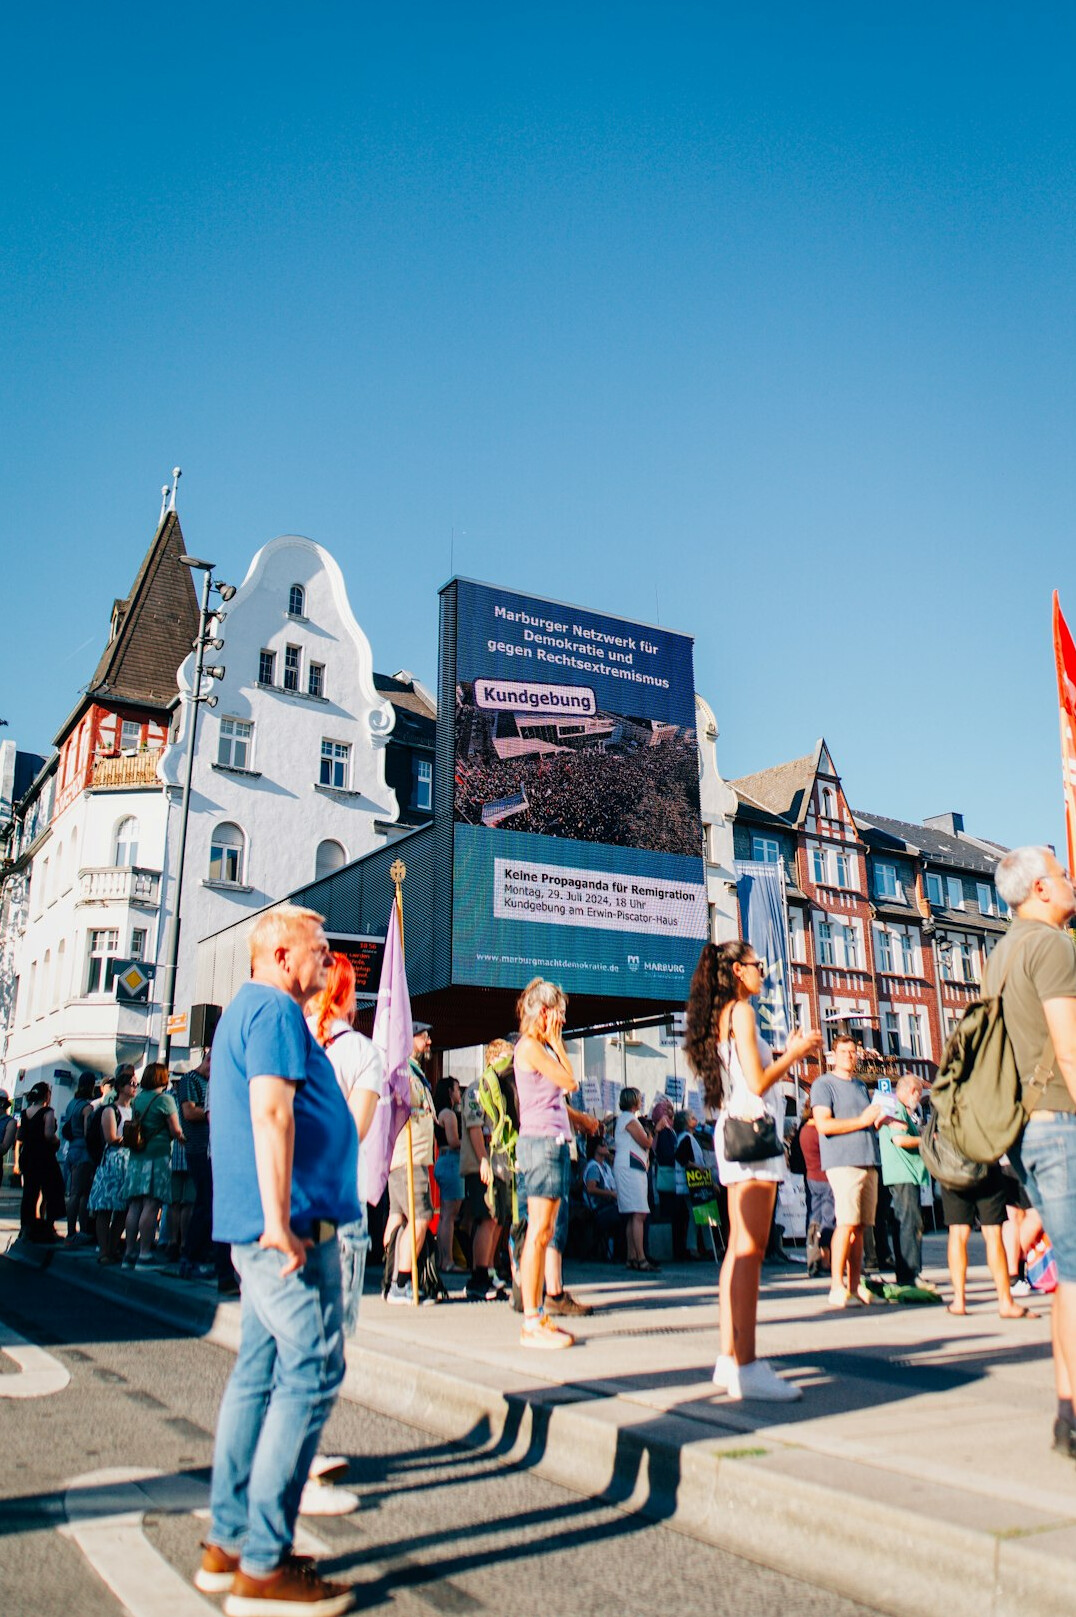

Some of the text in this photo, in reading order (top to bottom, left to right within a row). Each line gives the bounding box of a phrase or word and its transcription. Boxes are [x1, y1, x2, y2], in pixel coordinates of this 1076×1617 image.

[494, 606, 659, 655] Marburger Netzwerk für
[524, 629, 633, 664] Demokratie und
[488, 640, 670, 689] gegen Rechtsextremismus
[484, 687, 591, 711] Kundgebung
[504, 884, 646, 909] Montag, 29. Juli 2024, 18 Uhr
[505, 869, 695, 901] Keine Propaganda für Remigration
[504, 898, 678, 926] Kundgebung am Erwin-Piscator-Haus
[476, 953, 619, 973] www.marburgmachtdemokratie.de
[644, 962, 685, 974] MARBURG
[881, 1080, 888, 1092] P
